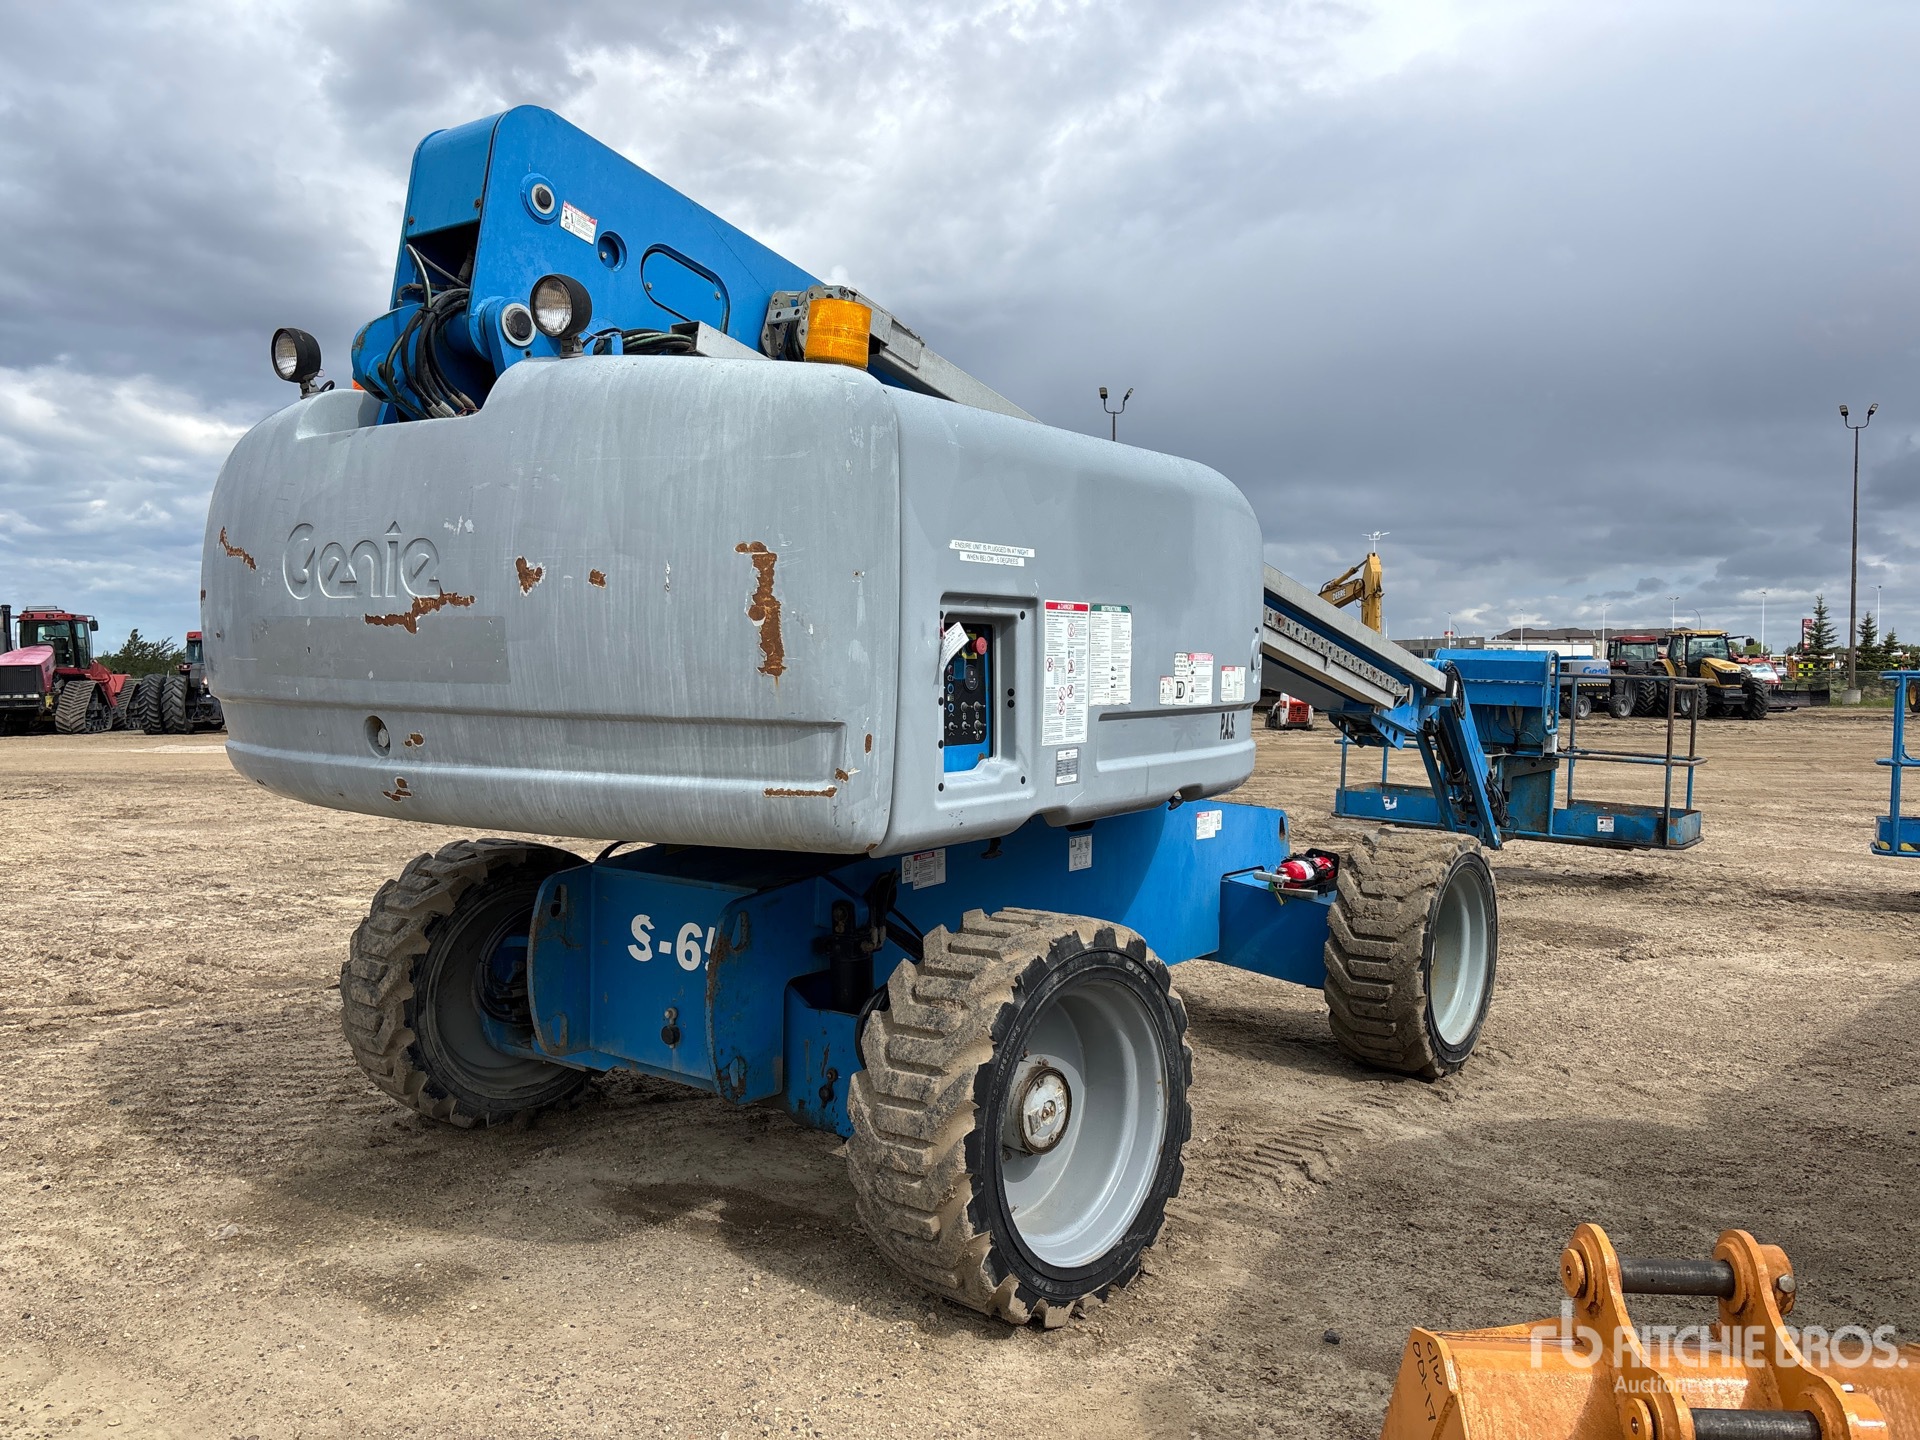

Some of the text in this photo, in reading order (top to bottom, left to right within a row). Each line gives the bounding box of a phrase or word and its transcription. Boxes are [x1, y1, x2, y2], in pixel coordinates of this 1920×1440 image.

[954, 541, 972, 550] ENSURE
[973, 543, 982, 551] UNIT
[988, 546, 1006, 554] PLUGGED
[282, 521, 440, 600] Genie
[966, 553, 979, 561] WHEN
[980, 554, 994, 562] BELOW
[1000, 557, 1019, 565] DEGREES
[1332, 588, 1346, 601] DEERE
